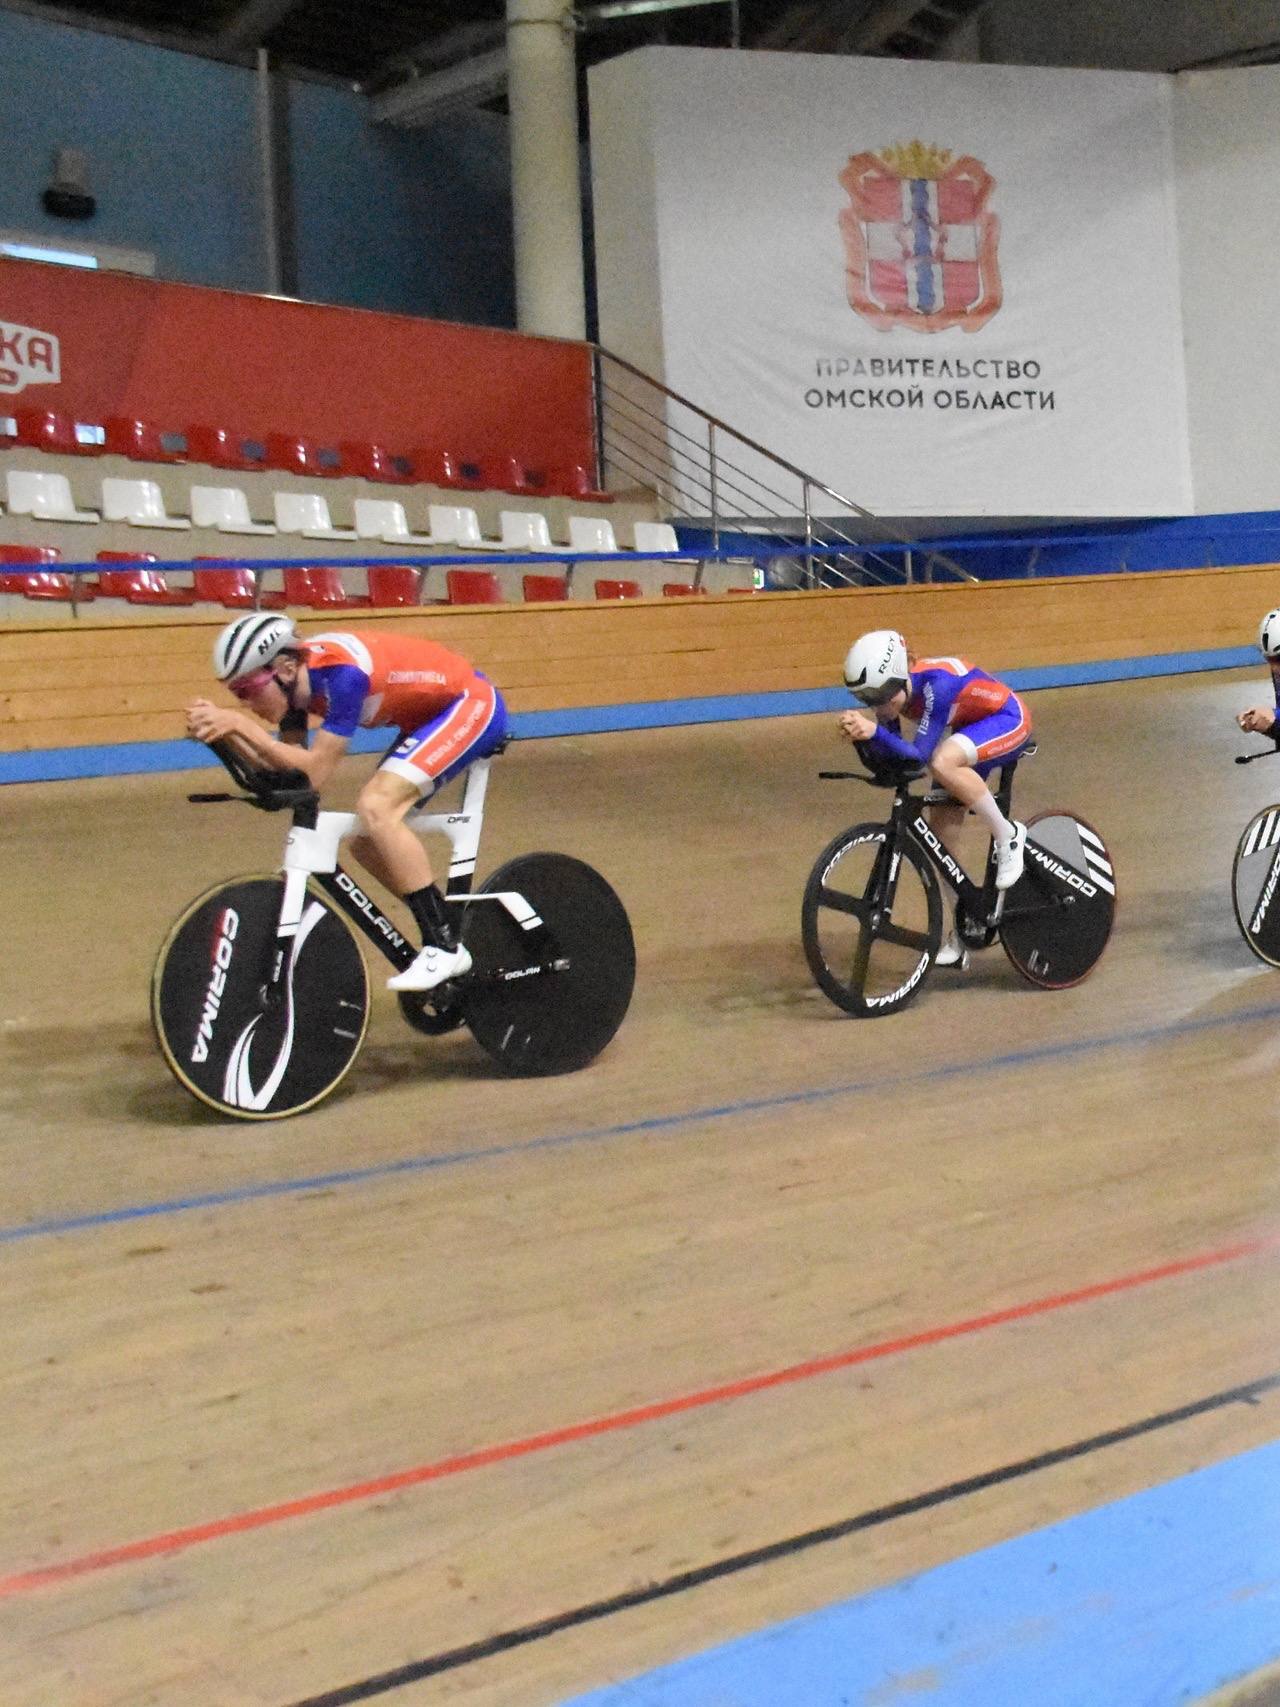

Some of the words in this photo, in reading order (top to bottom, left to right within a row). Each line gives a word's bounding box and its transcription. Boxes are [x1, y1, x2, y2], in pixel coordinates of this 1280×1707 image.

[803, 384, 924, 409] ОМСКОЙ
[933, 389, 1055, 410] ОБЛАСТИ
[815, 357, 1041, 379] ПРАВИТЕЛЬСТВО
[913, 816, 965, 885] DOLAN
[335, 872, 405, 949] DOLAN
[190, 907, 240, 1063] CORIMA
[865, 951, 930, 1008] CORIMA
